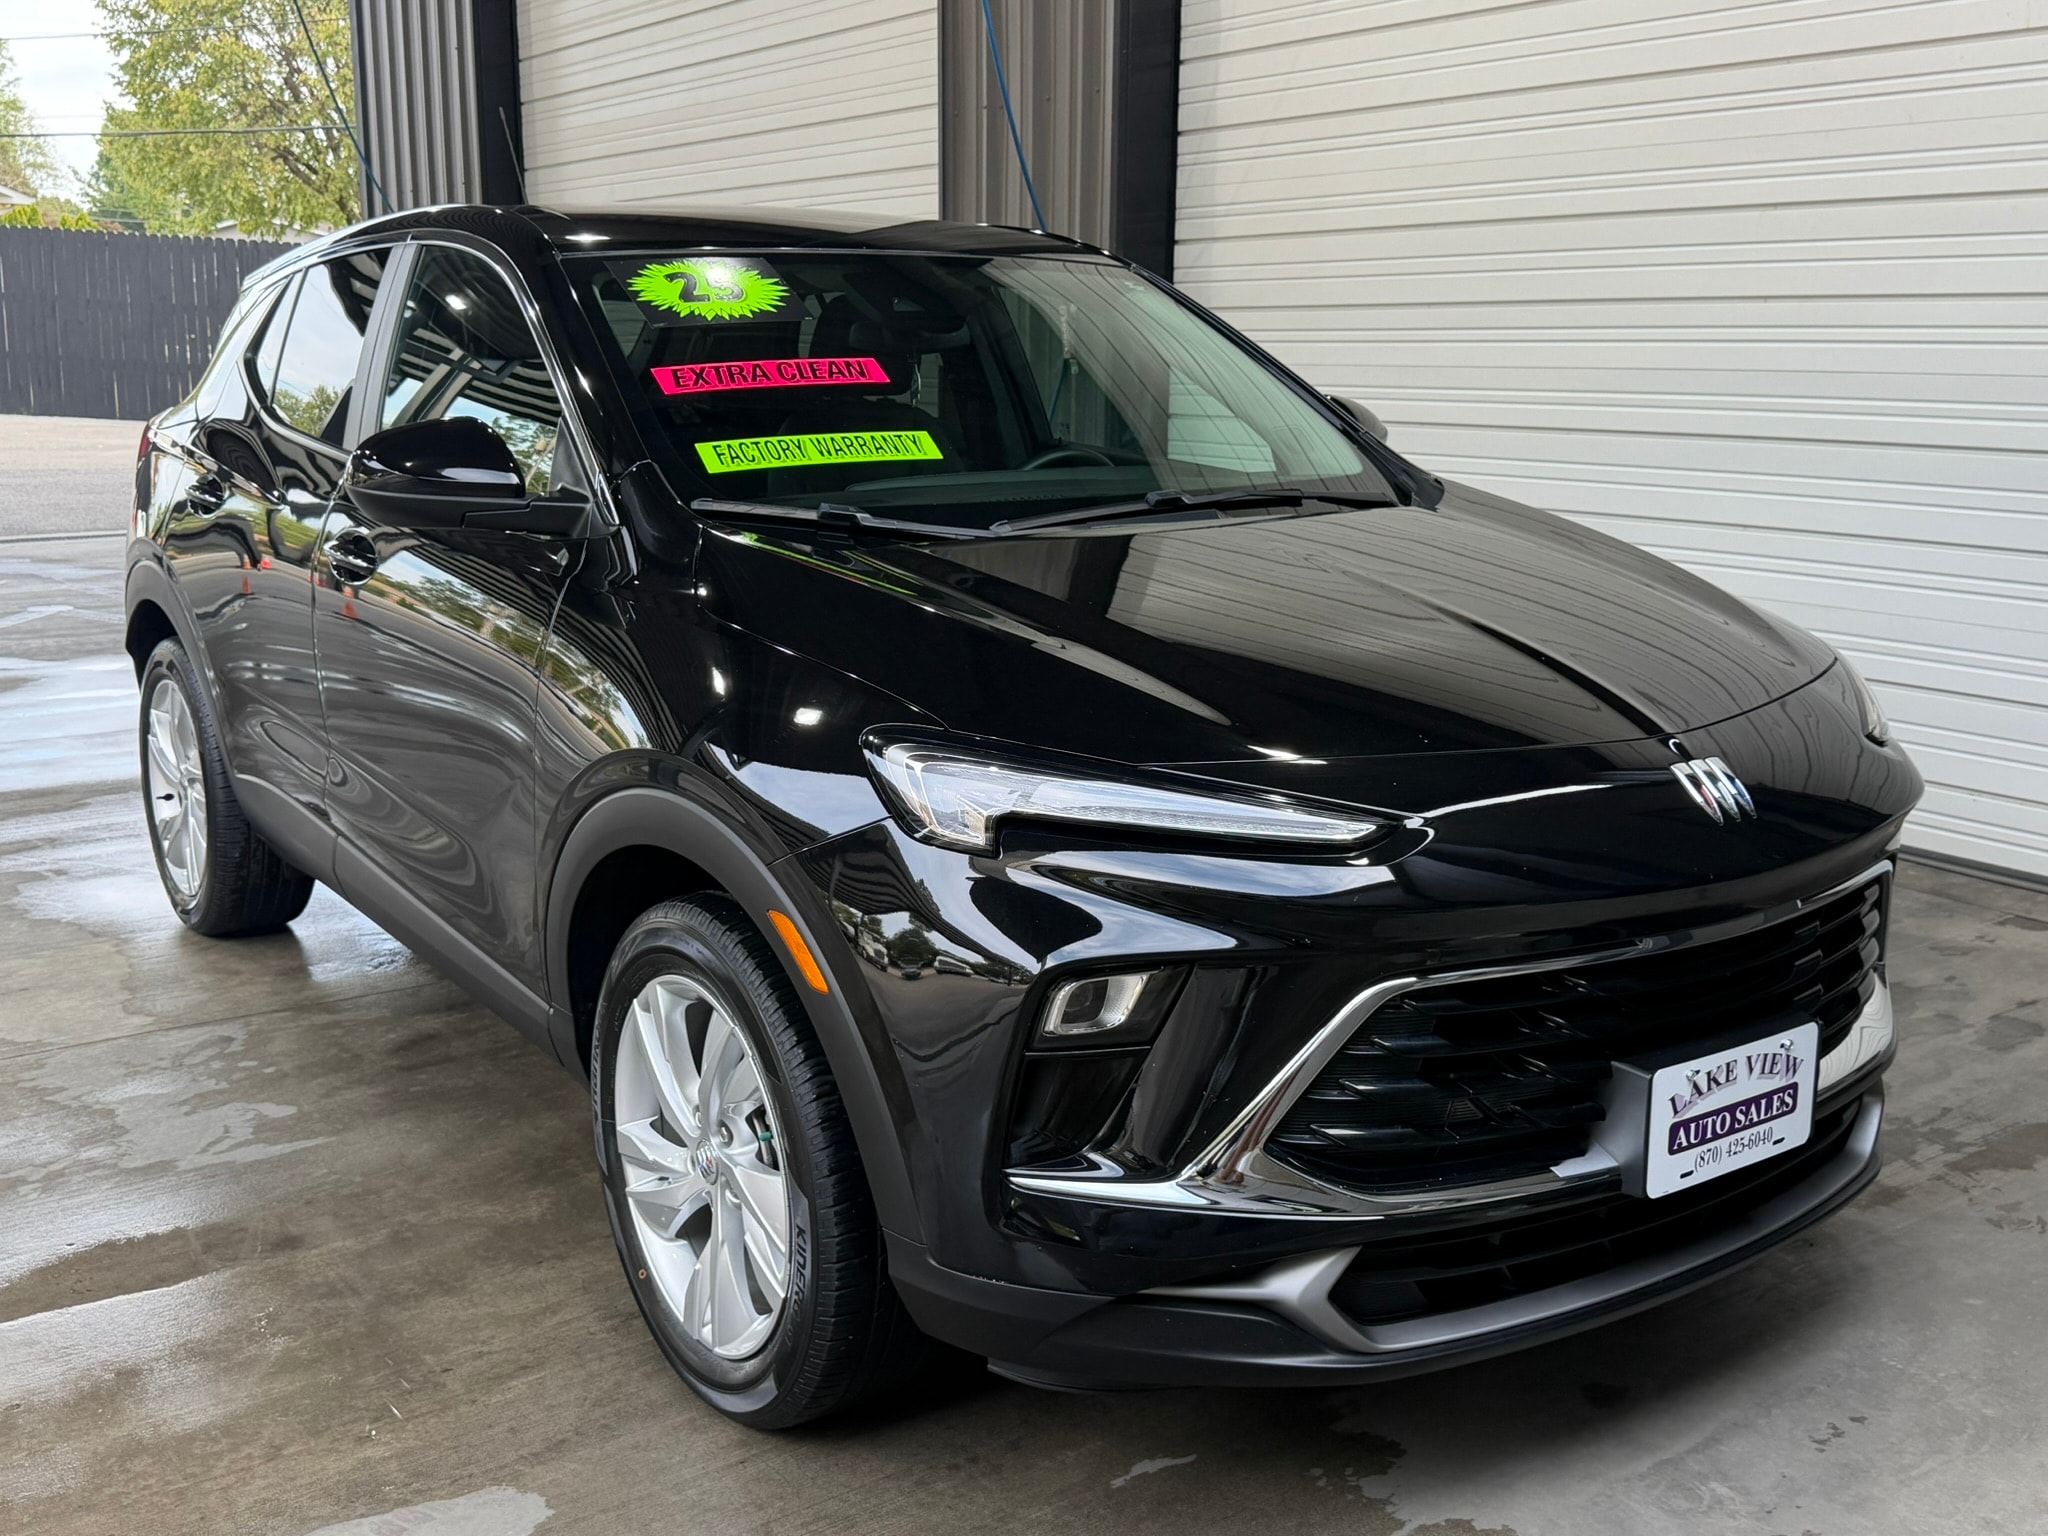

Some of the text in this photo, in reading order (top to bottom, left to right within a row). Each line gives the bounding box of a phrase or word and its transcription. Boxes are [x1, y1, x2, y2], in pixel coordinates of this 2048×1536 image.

[672, 360, 867, 388] EXTRA CLEAN
[713, 434, 923, 466] FACTORY WARRANTY
[1668, 1052, 1804, 1118] LAKE VIEW
[1672, 1089, 1794, 1150] AUTO SALES
[1695, 1127, 1773, 1172] (870) 425-6040
